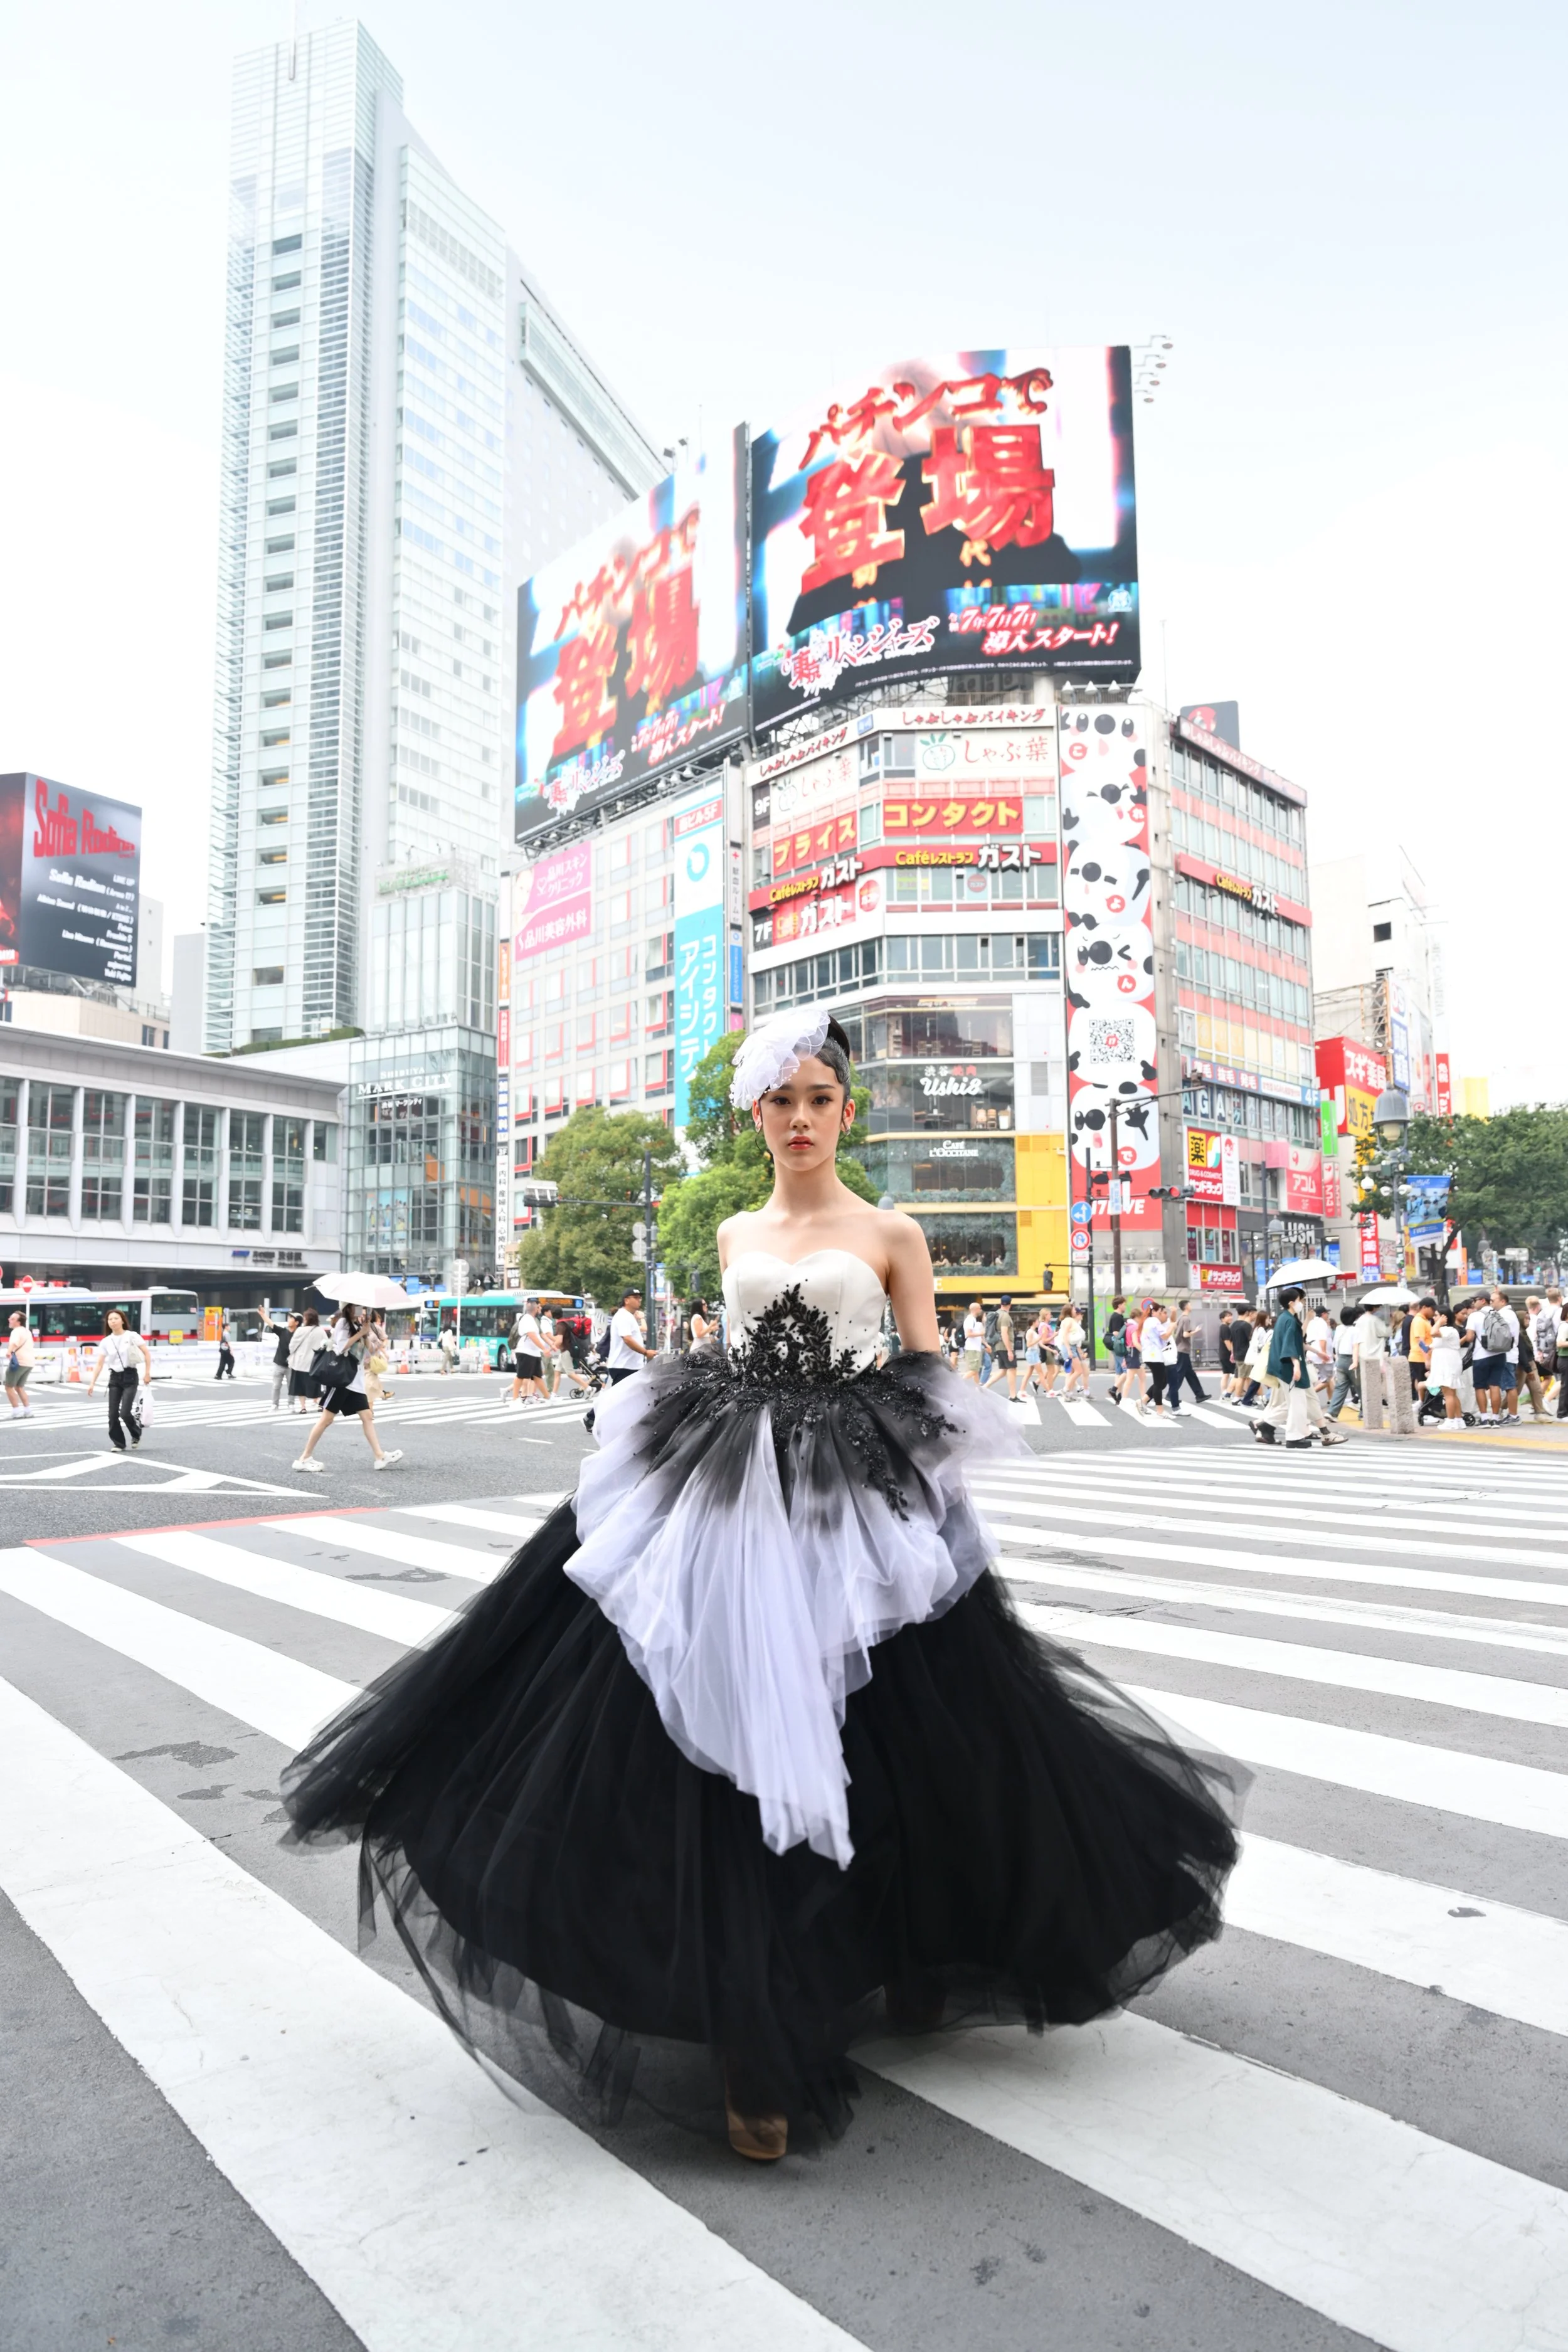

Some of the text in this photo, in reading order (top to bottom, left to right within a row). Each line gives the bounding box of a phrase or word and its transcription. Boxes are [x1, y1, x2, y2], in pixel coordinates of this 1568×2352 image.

[799, 368, 1054, 470] パチンコで
[798, 424, 1056, 596] 登場
[552, 566, 700, 758] 登場
[901, 708, 1046, 726] しゃぶしゃぶバイキング
[760, 726, 848, 777] しゃぶしゃぶバイキング
[964, 735, 1049, 763] しゃぶ葉
[34, 778, 77, 858] Sofia
[755, 797, 771, 816] 9F
[884, 800, 1019, 829] コンタクト
[977, 844, 1042, 870] ガスト
[820, 857, 864, 890] ガスト
[1252, 886, 1279, 914] ガスト
[799, 895, 854, 937] ガスト
[754, 918, 773, 943] 7F
[358, 1073, 451, 1095] MARK CITY
[380, 1067, 425, 1080] SHIBUYA
[1345, 1050, 1386, 1091] スギ薬局
[919, 1076, 982, 1096] Ushi8
[1305, 1088, 1320, 1106] 4F
[1348, 1095, 1375, 1132] 処方
[1190, 1135, 1205, 1163] 薬
[1293, 1173, 1316, 1194] アコム
[1091, 1199, 1145, 1215] 17VE
[1280, 1221, 1315, 1245] LUSH
[1212, 1271, 1241, 1283] サンドラッグ
